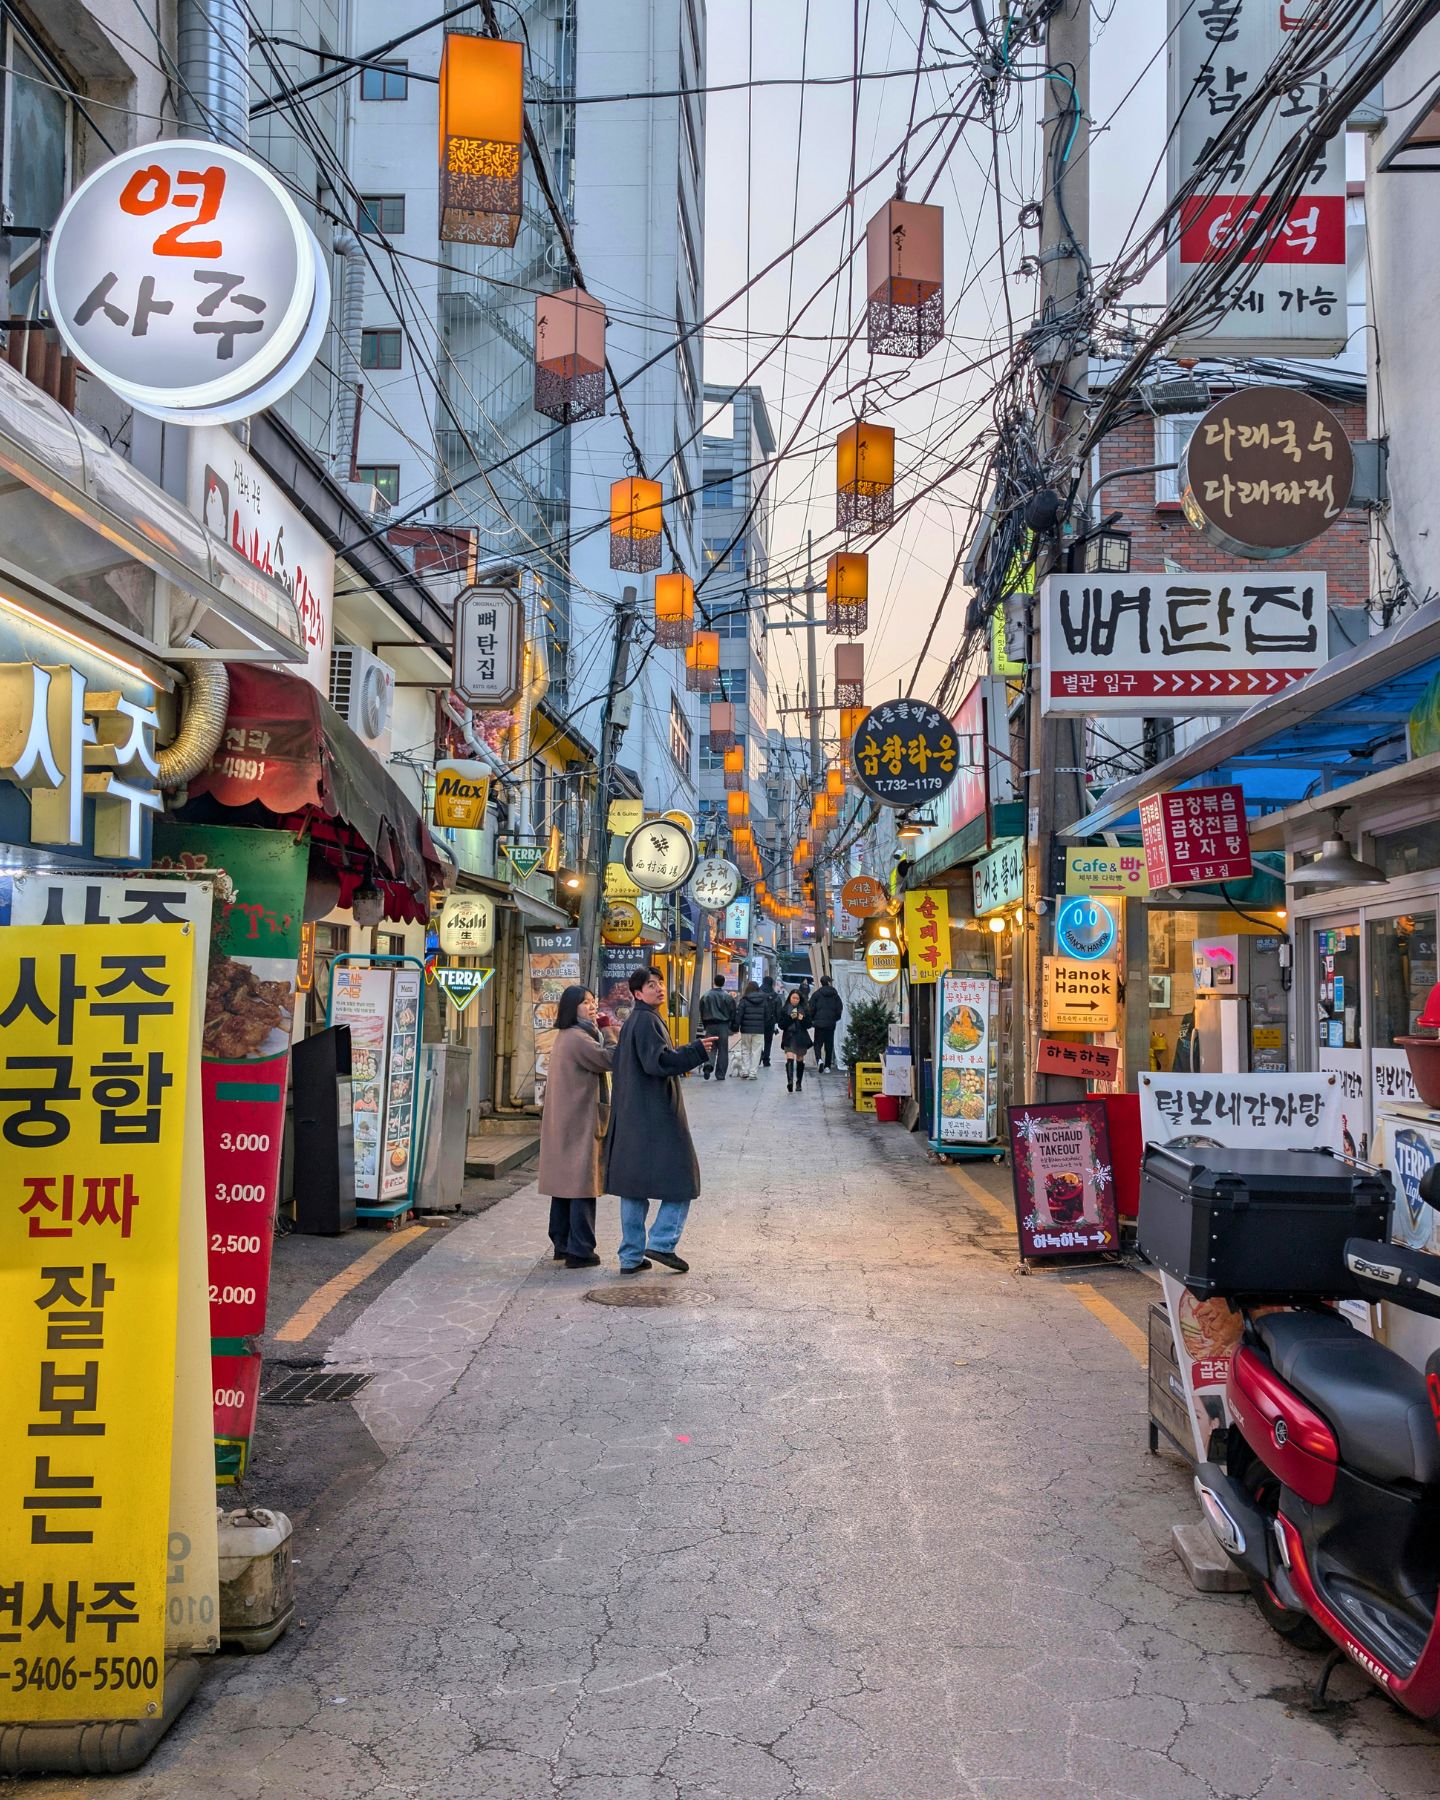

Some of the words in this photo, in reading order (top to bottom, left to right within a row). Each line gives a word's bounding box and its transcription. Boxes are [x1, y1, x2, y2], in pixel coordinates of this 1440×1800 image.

[1278, 286, 1338, 316] 가능
[73, 270, 267, 359] 사주
[1203, 417, 1334, 463] 다래국수
[1203, 474, 1340, 519] 다래파전
[1060, 586, 1318, 656] 뼈탄집
[476, 609, 498, 680] 뼈탄집
[1062, 674, 1097, 693] 별관
[1104, 674, 1138, 693] 입구
[12, 664, 165, 862] 사주
[439, 778, 484, 798] Max
[876, 778, 942, 791] T.732-1179
[1169, 792, 1236, 817] 곱창볶음
[1171, 814, 1239, 838] 곱창전골
[507, 848, 542, 860] TERRA
[1174, 836, 1242, 859] 감자탕
[704, 861, 729, 879] 동해
[1072, 858, 1108, 872] Cafe
[1110, 863, 1117, 872] &
[1121, 857, 1145, 881] 빵
[1190, 864, 1229, 880] 털보집
[695, 877, 733, 896] 남부선
[447, 913, 487, 929] Asahi
[461, 931, 472, 939] 生
[534, 936, 553, 947] The
[556, 936, 572, 947] 9.2
[1066, 930, 1086, 952] HANOK
[1087, 932, 1109, 952] HANOK
[438, 970, 482, 986] TERRA
[1055, 967, 1111, 981] Hanok
[1055, 981, 1111, 994] Hanok
[0, 954, 174, 1045] 사주
[1047, 1045, 1110, 1066] 하녹하녹
[0, 1052, 172, 1148] 궁합
[1155, 1089, 1325, 1127] 털보네감자탕
[220, 1133, 270, 1152] 3,000
[1035, 1131, 1050, 1143] VIN
[1052, 1130, 1083, 1142] CHAUD
[1039, 1144, 1080, 1156] TAKEOUT
[1396, 1142, 1431, 1177] TERRA
[215, 1183, 265, 1203] 3,000
[18, 1174, 139, 1239] 진짜
[211, 1234, 261, 1254] 2,500
[209, 1285, 256, 1305] 2,000
[1346, 1640, 1390, 1688] YAMAHA
